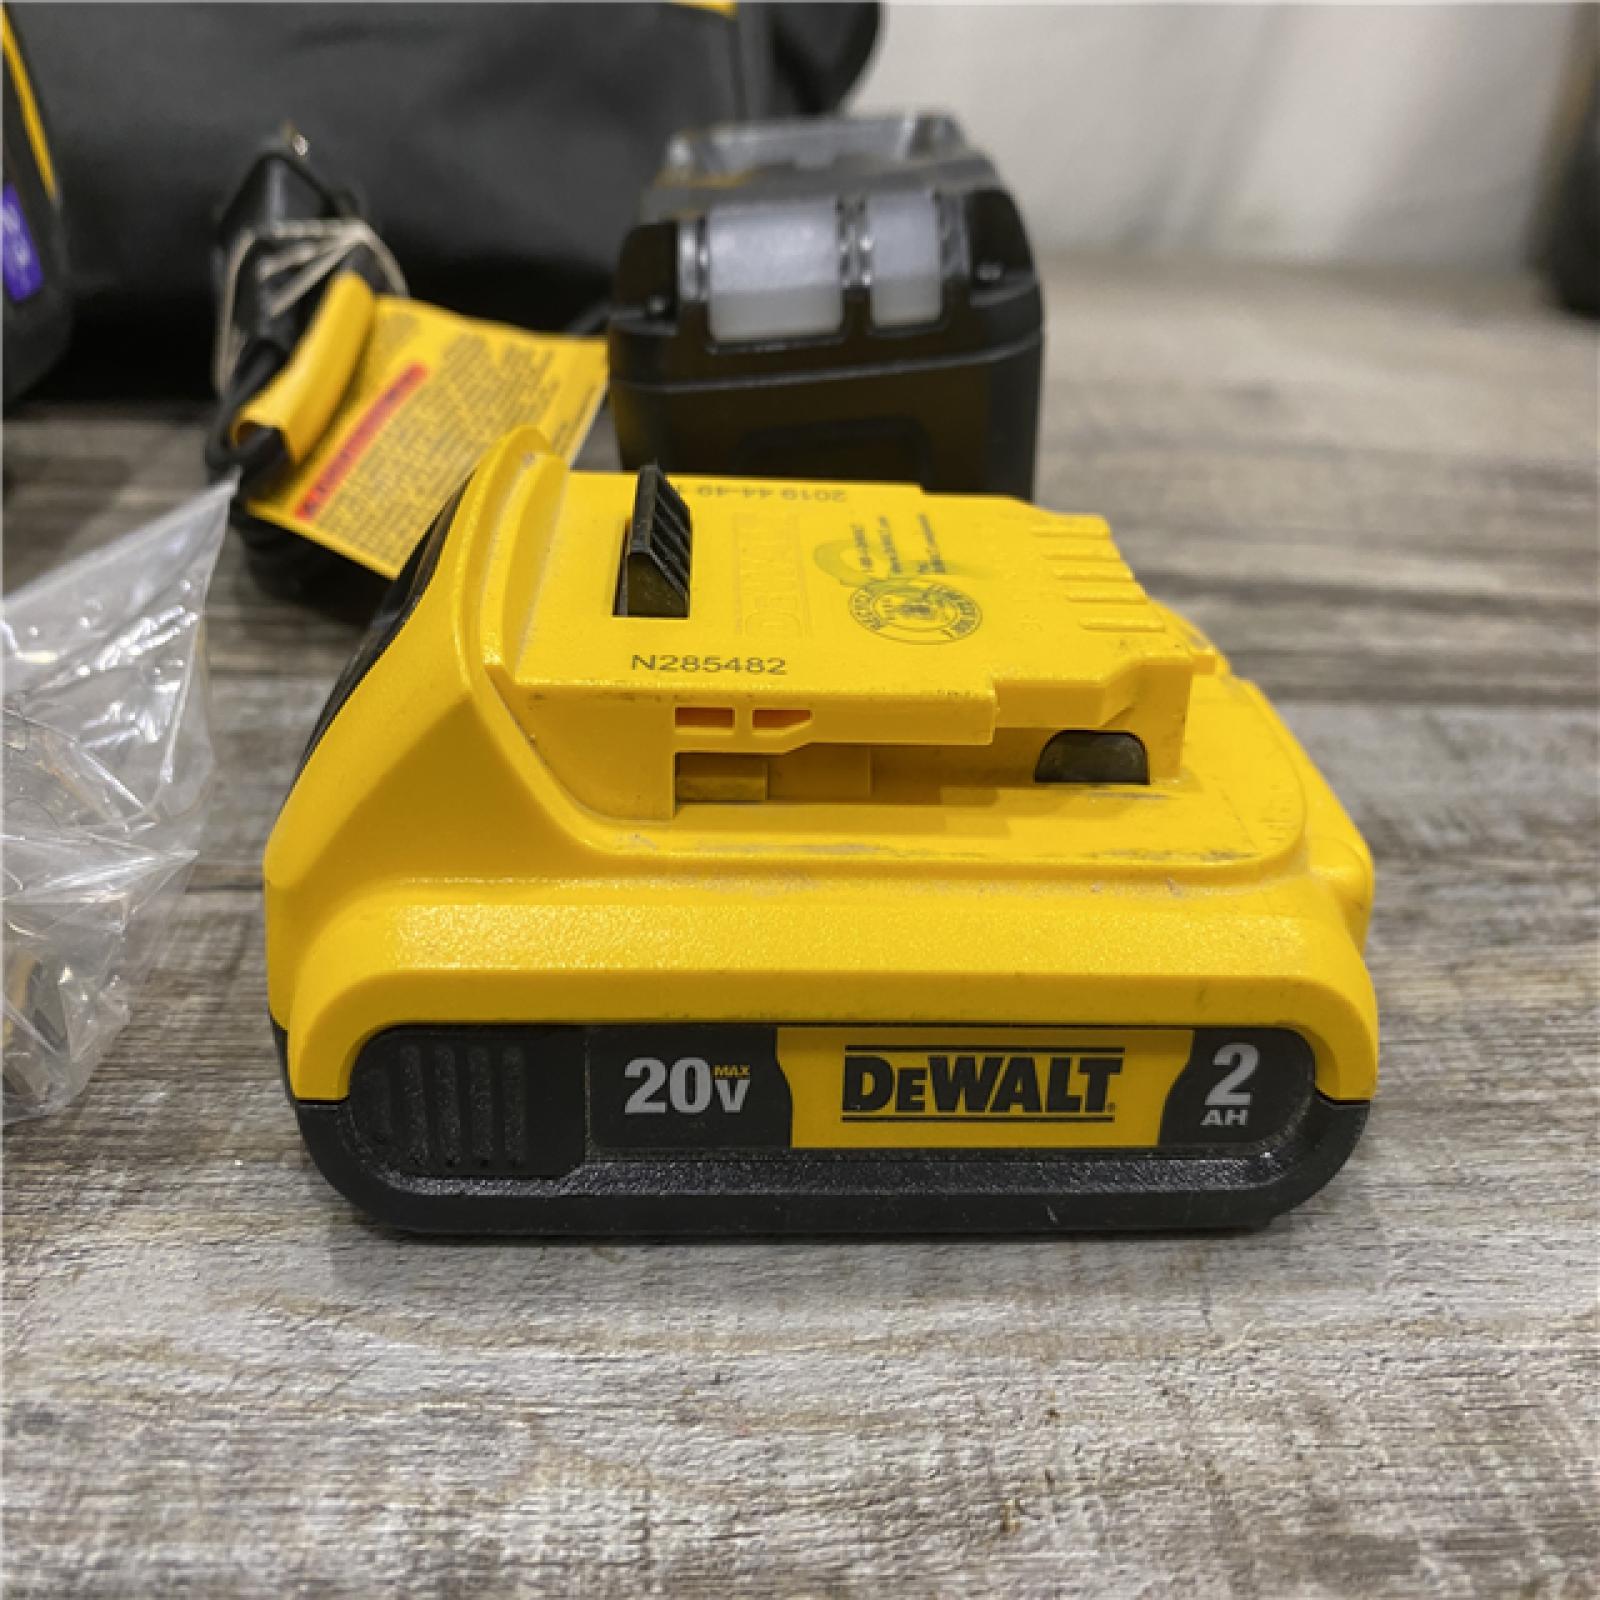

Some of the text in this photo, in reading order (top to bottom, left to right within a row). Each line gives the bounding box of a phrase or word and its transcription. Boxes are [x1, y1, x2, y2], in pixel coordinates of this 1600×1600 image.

[631, 654, 788, 676] N285482
[714, 1064, 751, 1077] MAX
[1204, 1043, 1260, 1106] 2
[842, 1056, 1123, 1113] DEWALT
[1200, 1109, 1249, 1126] AH
